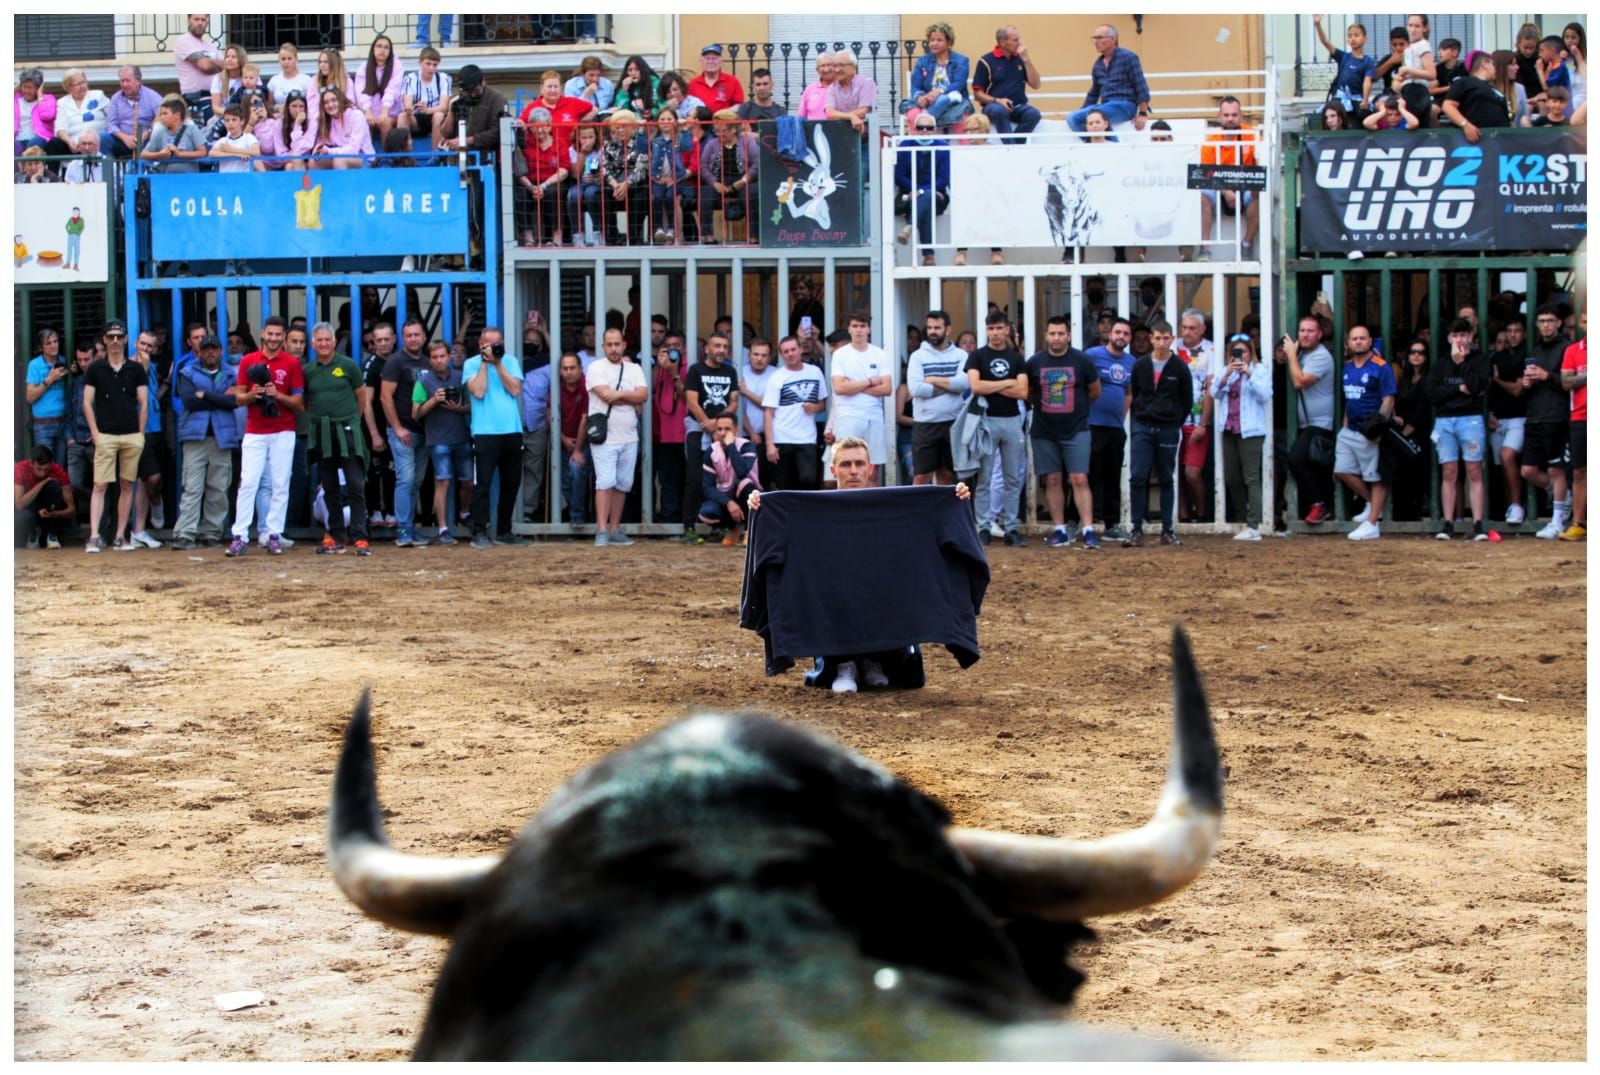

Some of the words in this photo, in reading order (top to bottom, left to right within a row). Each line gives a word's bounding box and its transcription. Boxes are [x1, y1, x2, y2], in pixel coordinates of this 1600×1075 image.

[1213, 170, 1265, 179] AUTOMOVILES
[1315, 146, 1483, 188] UNO2
[1499, 154, 1587, 183] K2ST
[1499, 183, 1581, 196] QUALITY
[170, 195, 243, 216] COLLA
[1343, 189, 1475, 230] UNO
[1513, 204, 1553, 214] imprenta
[777, 229, 806, 245] Bugs
[812, 228, 848, 243] Bunny
[1341, 232, 1468, 241] AUTODEFENSA
